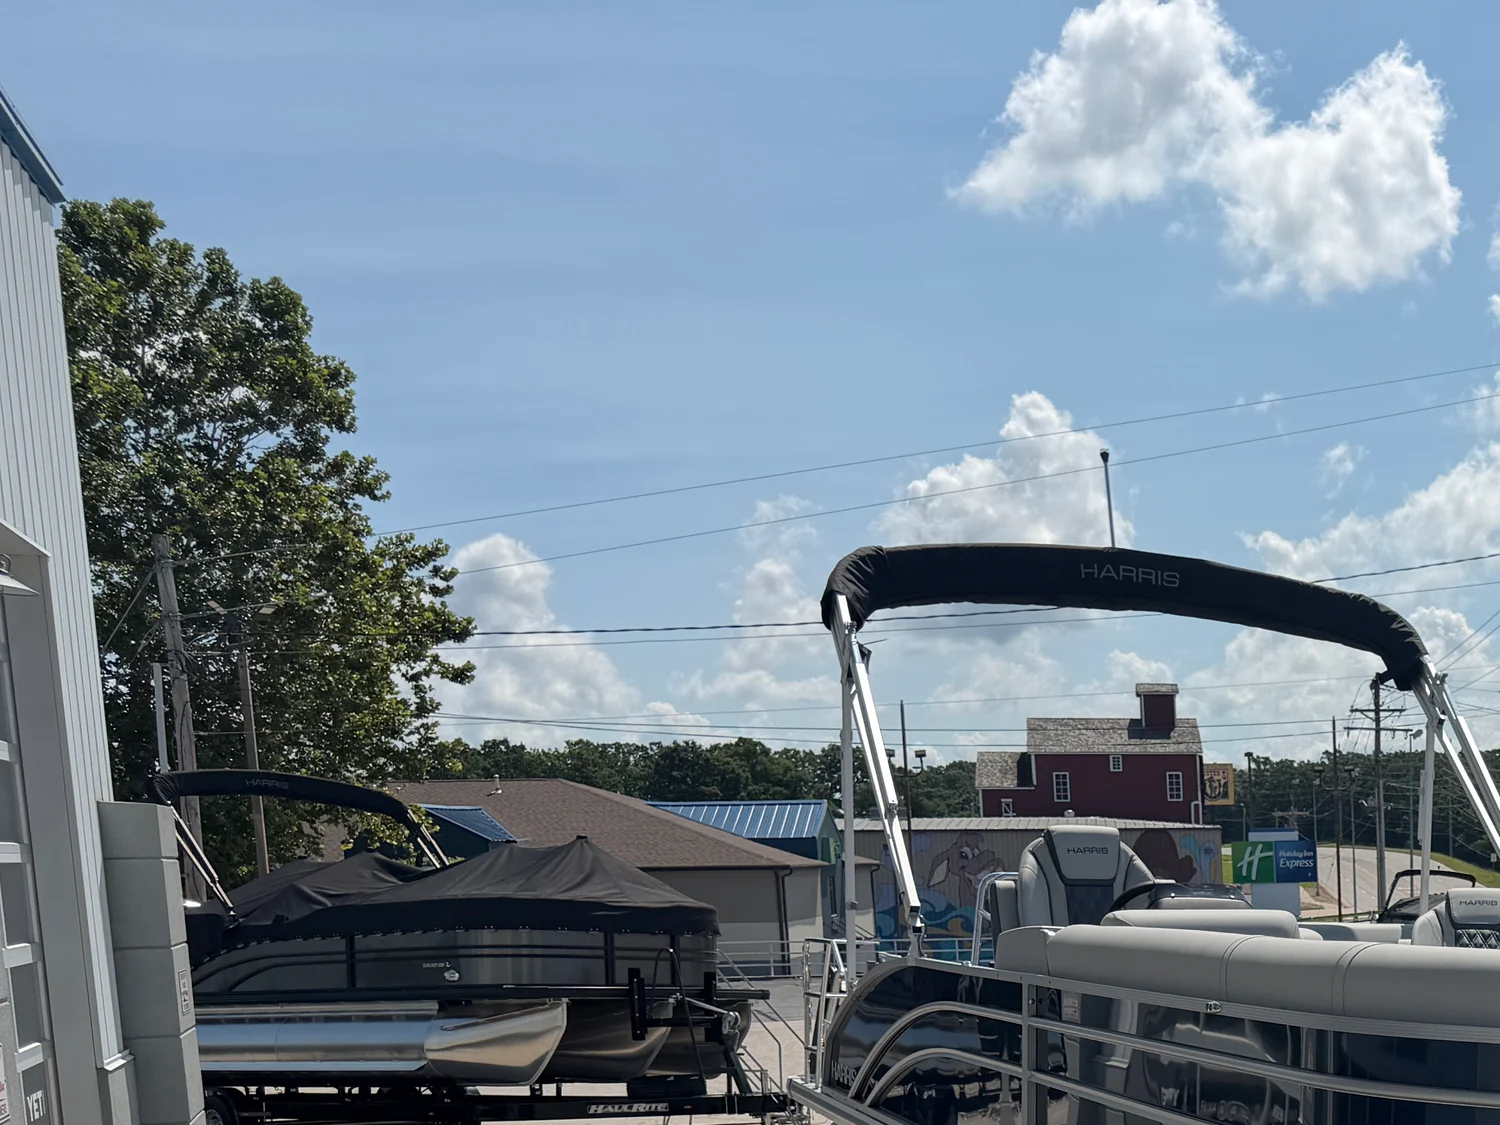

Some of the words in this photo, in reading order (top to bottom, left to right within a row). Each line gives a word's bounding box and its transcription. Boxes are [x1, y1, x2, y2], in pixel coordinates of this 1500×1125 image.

[1080, 563, 1180, 587] HARRIS
[245, 778, 290, 790] HARRIS
[1066, 846, 1109, 855] HARRIS
[1279, 850, 1303, 858] Holiday
[1279, 858, 1314, 869] Express
[26, 1090, 46, 1122] YETI
